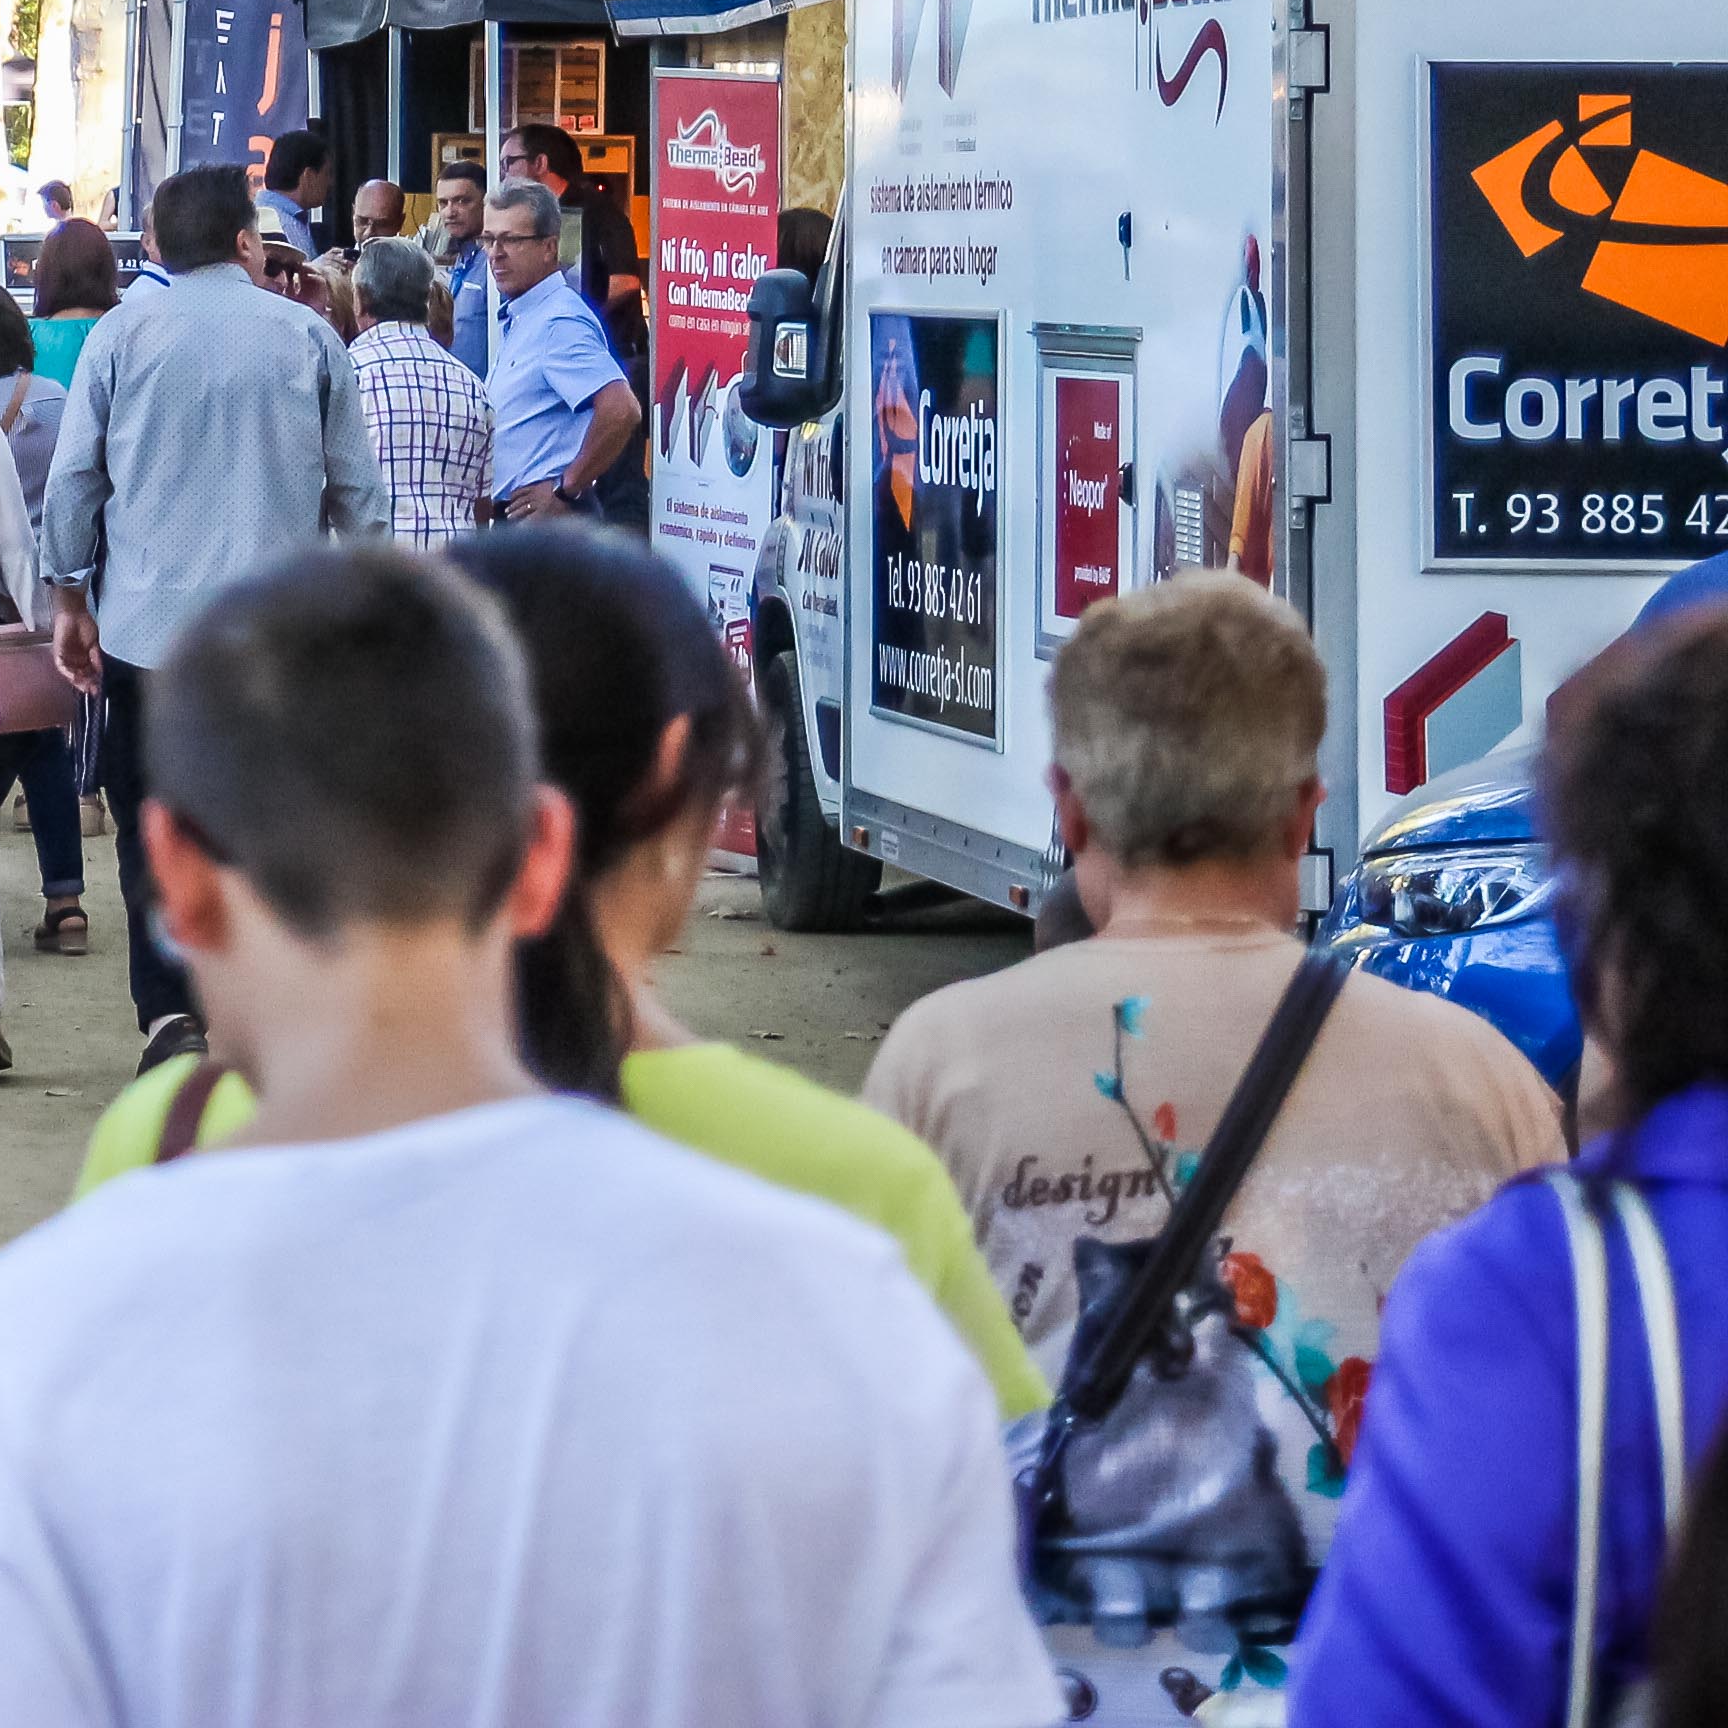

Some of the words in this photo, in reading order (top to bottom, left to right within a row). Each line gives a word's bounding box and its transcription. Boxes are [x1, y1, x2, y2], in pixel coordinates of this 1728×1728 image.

[870, 175, 902, 213] sistema
[903, 174, 915, 212] de
[916, 171, 972, 212] aislamiento
[974, 169, 1013, 211] térmico
[661, 237, 677, 273] Ni
[680, 237, 709, 283] frío,
[713, 241, 728, 278] ni
[882, 245, 893, 275] en
[894, 235, 928, 275] cámara
[929, 245, 951, 285] para
[953, 245, 966, 275] su
[968, 235, 999, 287] hogar
[668, 281, 688, 306] Con
[1449, 356, 1728, 463] Corret
[918, 389, 996, 517] Corretja
[1452, 493, 1488, 534] T.
[1506, 493, 1561, 534] 93
[1581, 493, 1665, 534] 885
[887, 552, 905, 610] Tel.
[907, 560, 921, 612] 93
[924, 567, 946, 618] 885
[949, 568, 964, 623] 42
[967, 572, 982, 626] 61
[878, 642, 993, 714] www.corretja-sl.com
[1003, 1153, 1157, 1226] design
